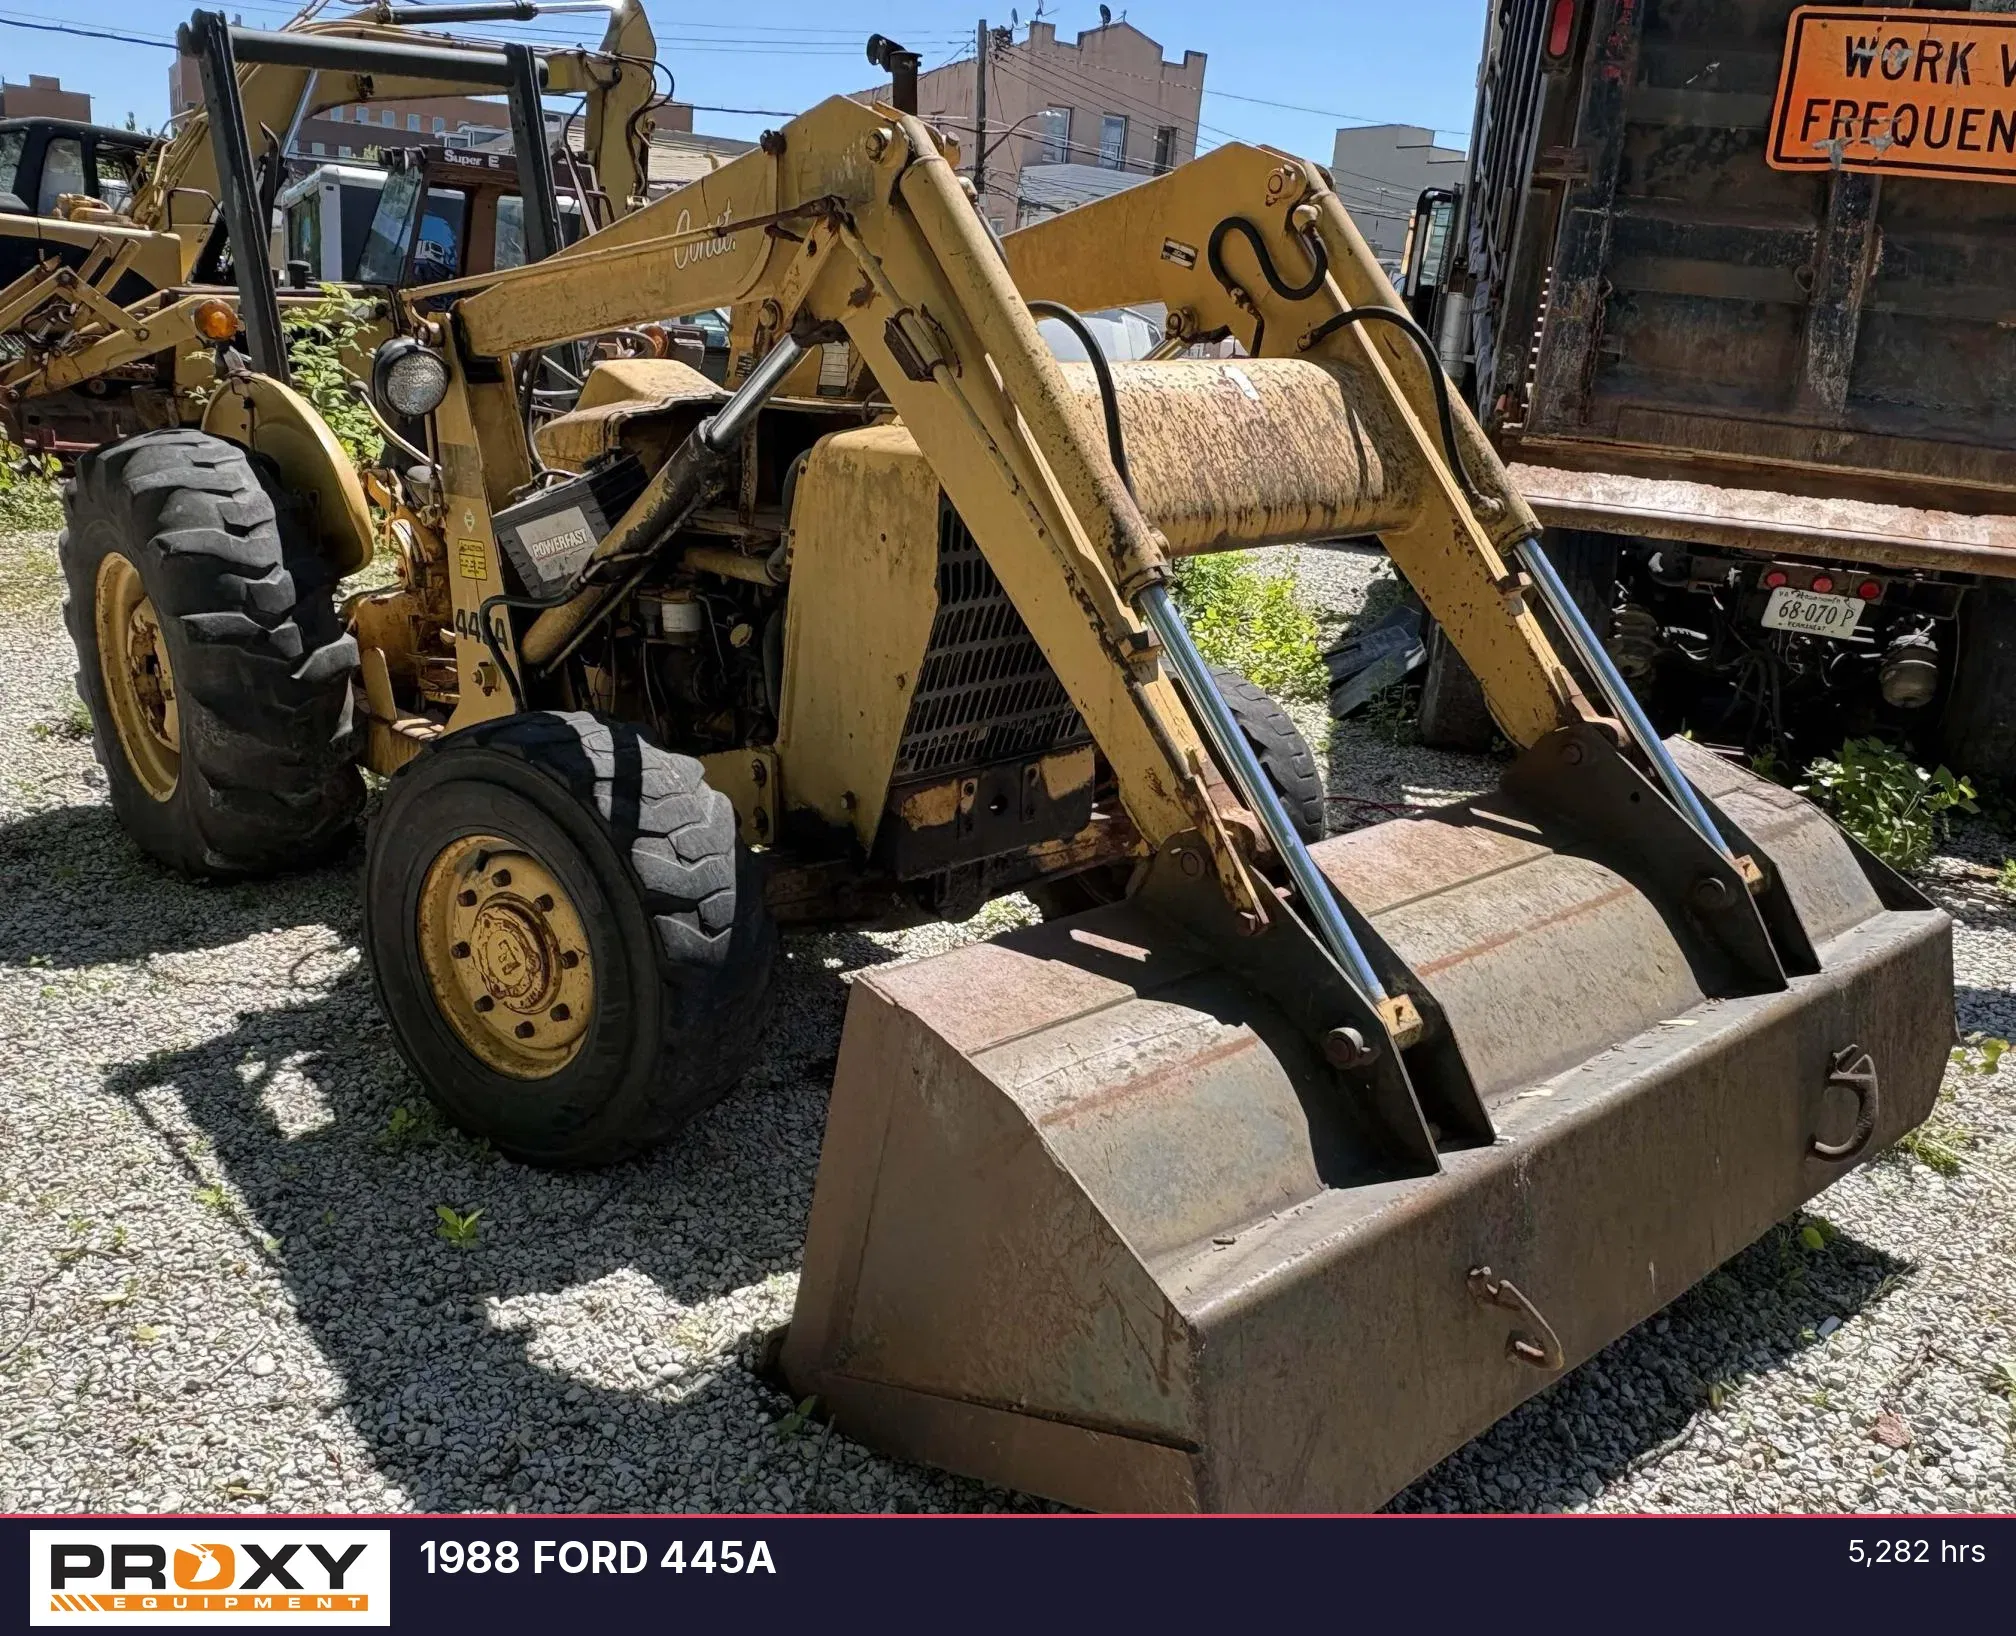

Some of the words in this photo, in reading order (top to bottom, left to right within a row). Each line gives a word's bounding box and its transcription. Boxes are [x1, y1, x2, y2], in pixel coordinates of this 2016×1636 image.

[1845, 36, 1977, 86] WORK
[1799, 98, 2016, 154] FREQUEN
[444, 149, 482, 167] Super
[488, 155, 500, 169] E
[532, 527, 588, 558] POWERFAST
[455, 608, 509, 652] 44A
[1840, 608, 1856, 627] P
